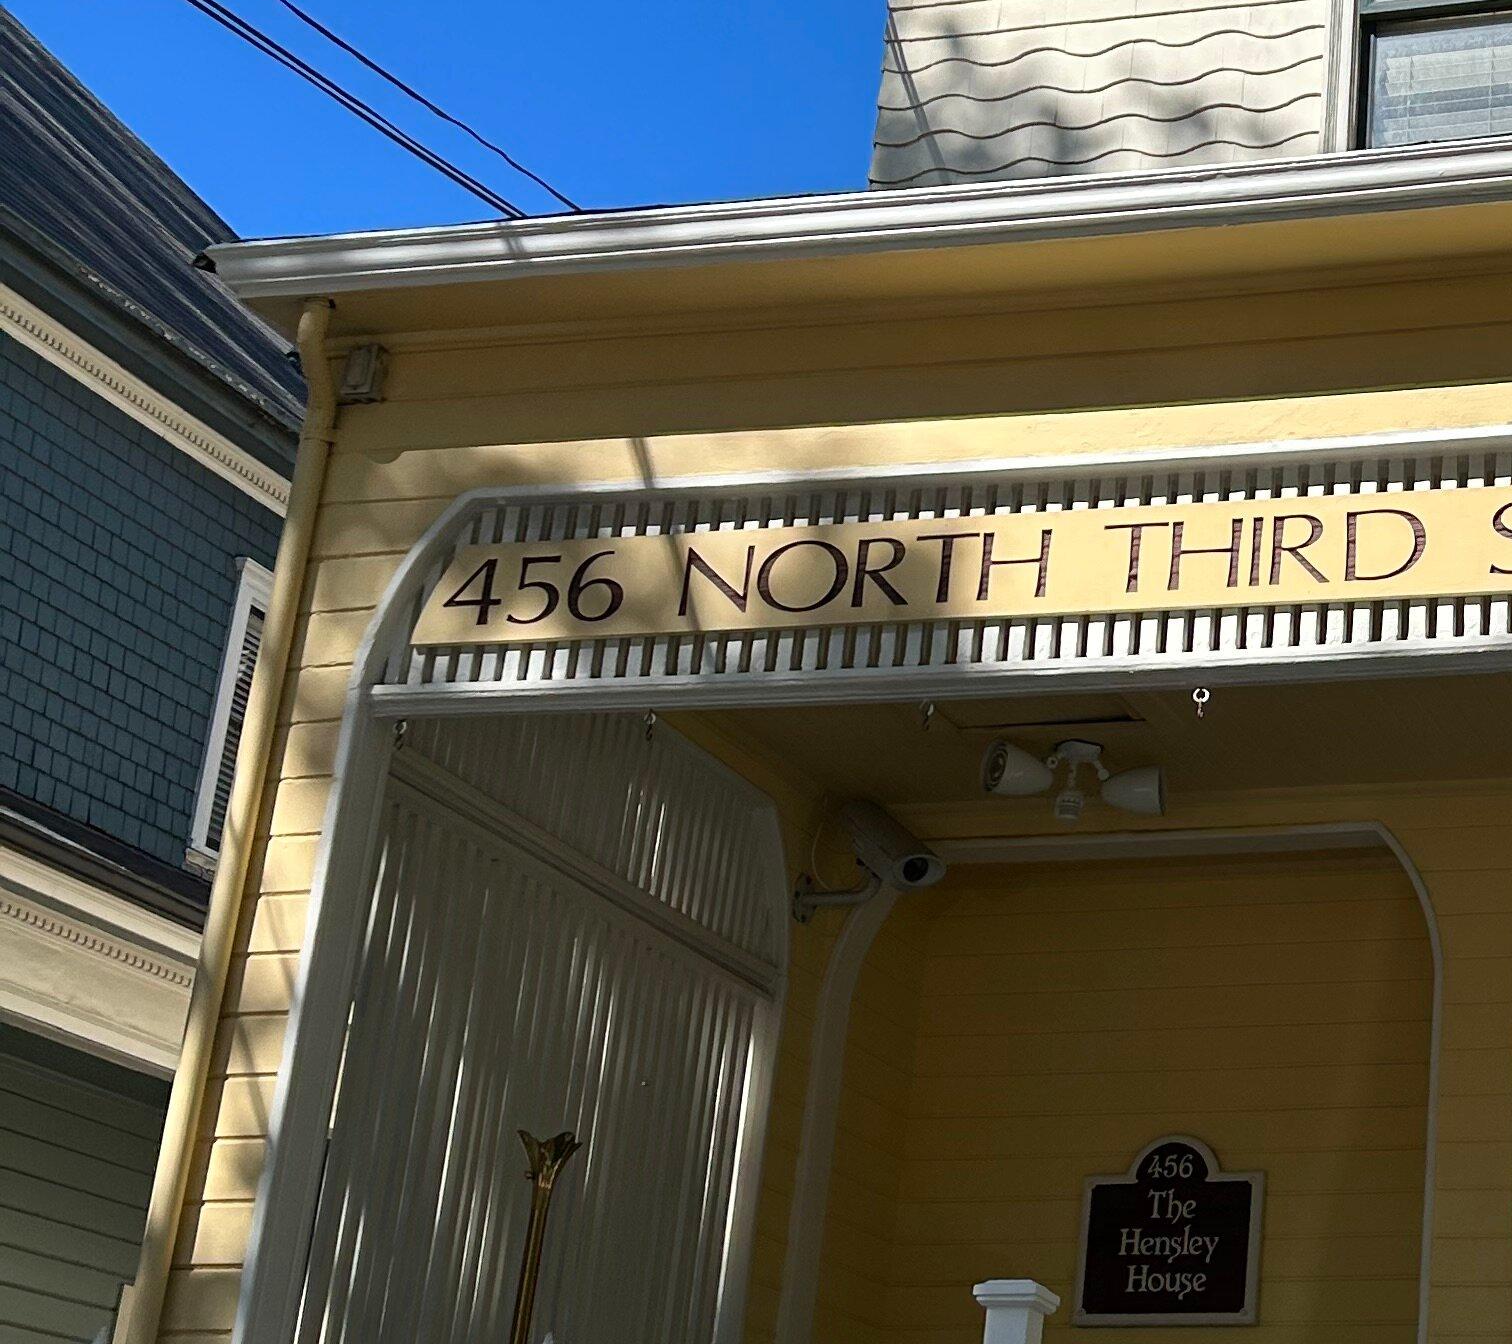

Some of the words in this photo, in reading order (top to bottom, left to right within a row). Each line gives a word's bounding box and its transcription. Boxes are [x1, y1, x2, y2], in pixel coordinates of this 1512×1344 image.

[443, 551, 624, 625] 456
[678, 529, 1053, 616] NORTH
[1104, 509, 1430, 593] THIRD
[1148, 1154, 1193, 1179] 456
[1148, 1188, 1197, 1225] The
[1118, 1224, 1220, 1264] Hensley
[1125, 1264, 1207, 1300] House
